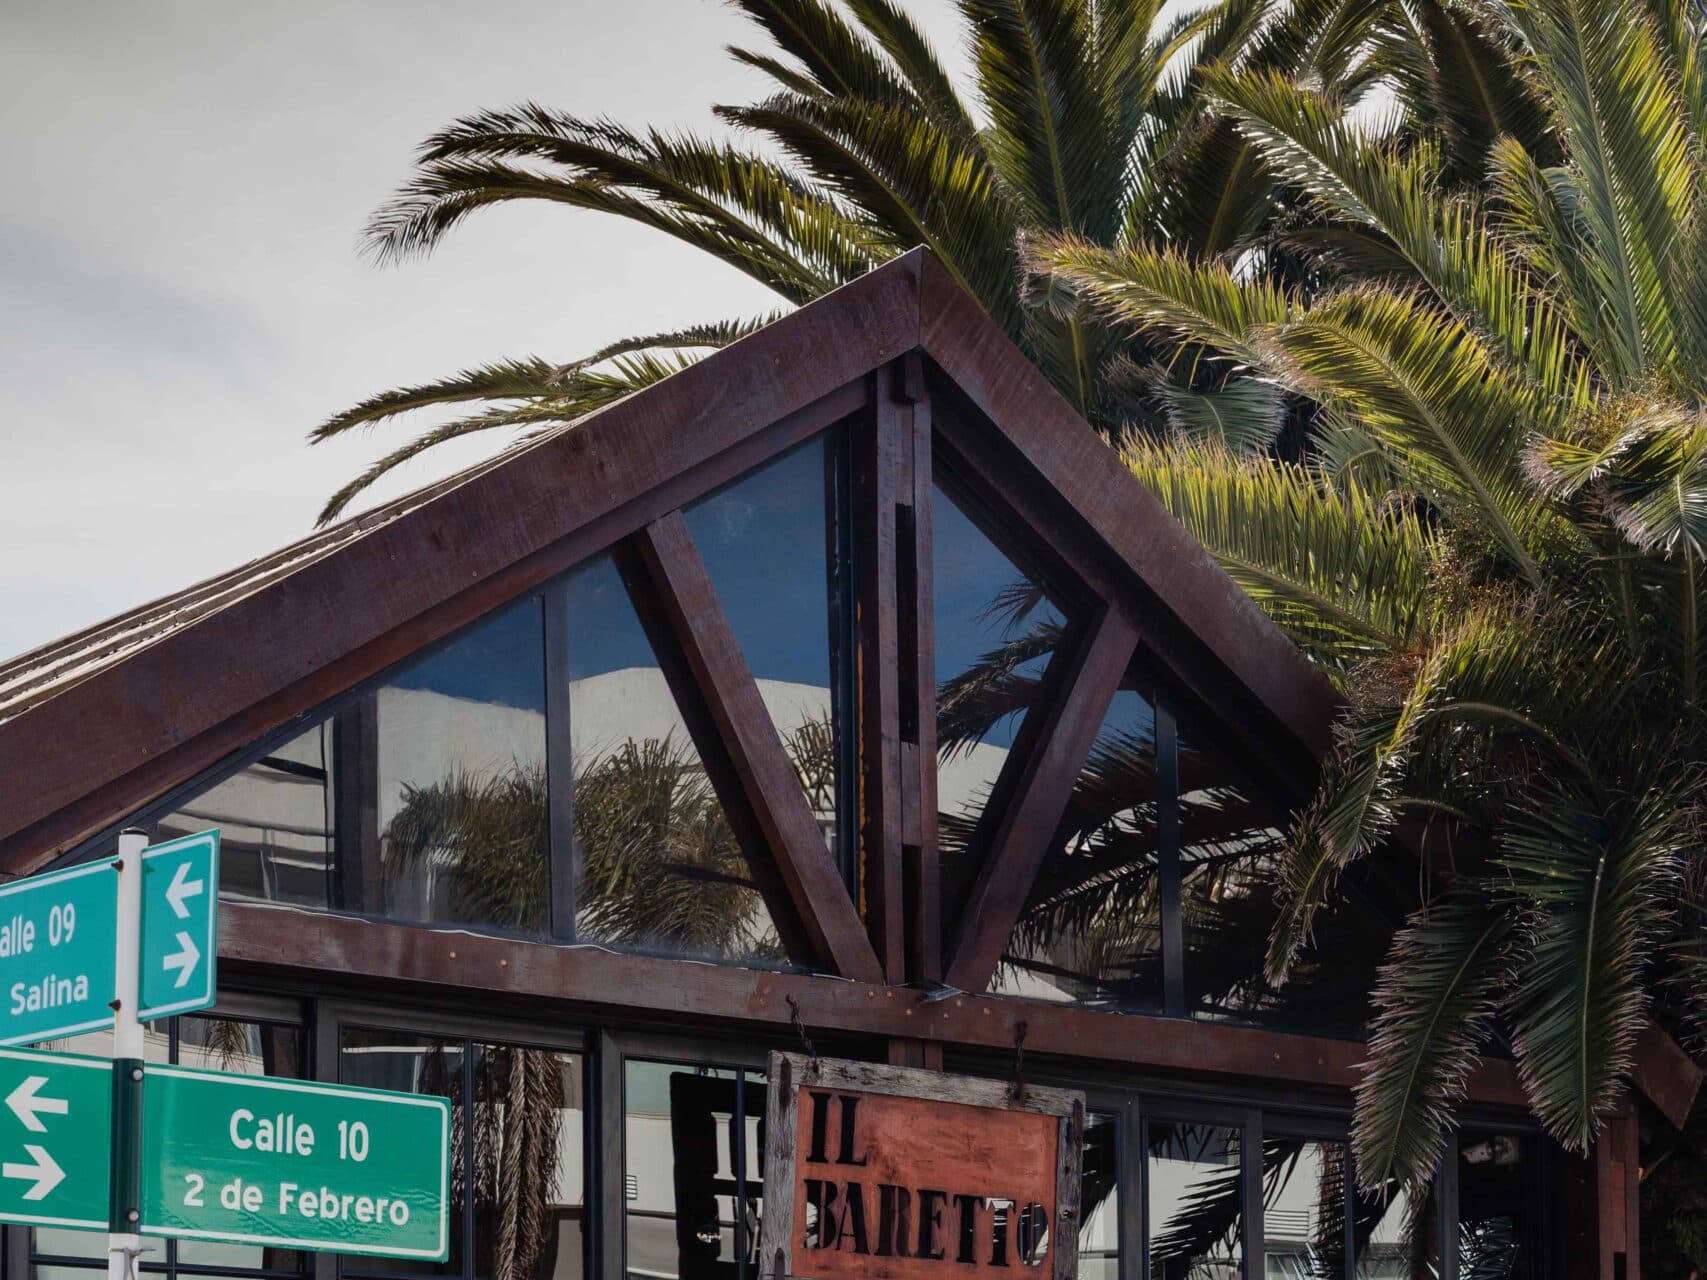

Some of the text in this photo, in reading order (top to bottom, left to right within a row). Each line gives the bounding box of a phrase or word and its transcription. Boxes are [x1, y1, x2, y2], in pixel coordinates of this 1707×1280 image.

[0, 903, 76, 957] alle 09
[10, 974, 88, 1016] Salina
[229, 1108, 369, 1162] Calle 10
[805, 1092, 868, 1167] IL
[183, 1174, 410, 1226] 2 de Febrero
[803, 1178, 1050, 1268] BARETTO
